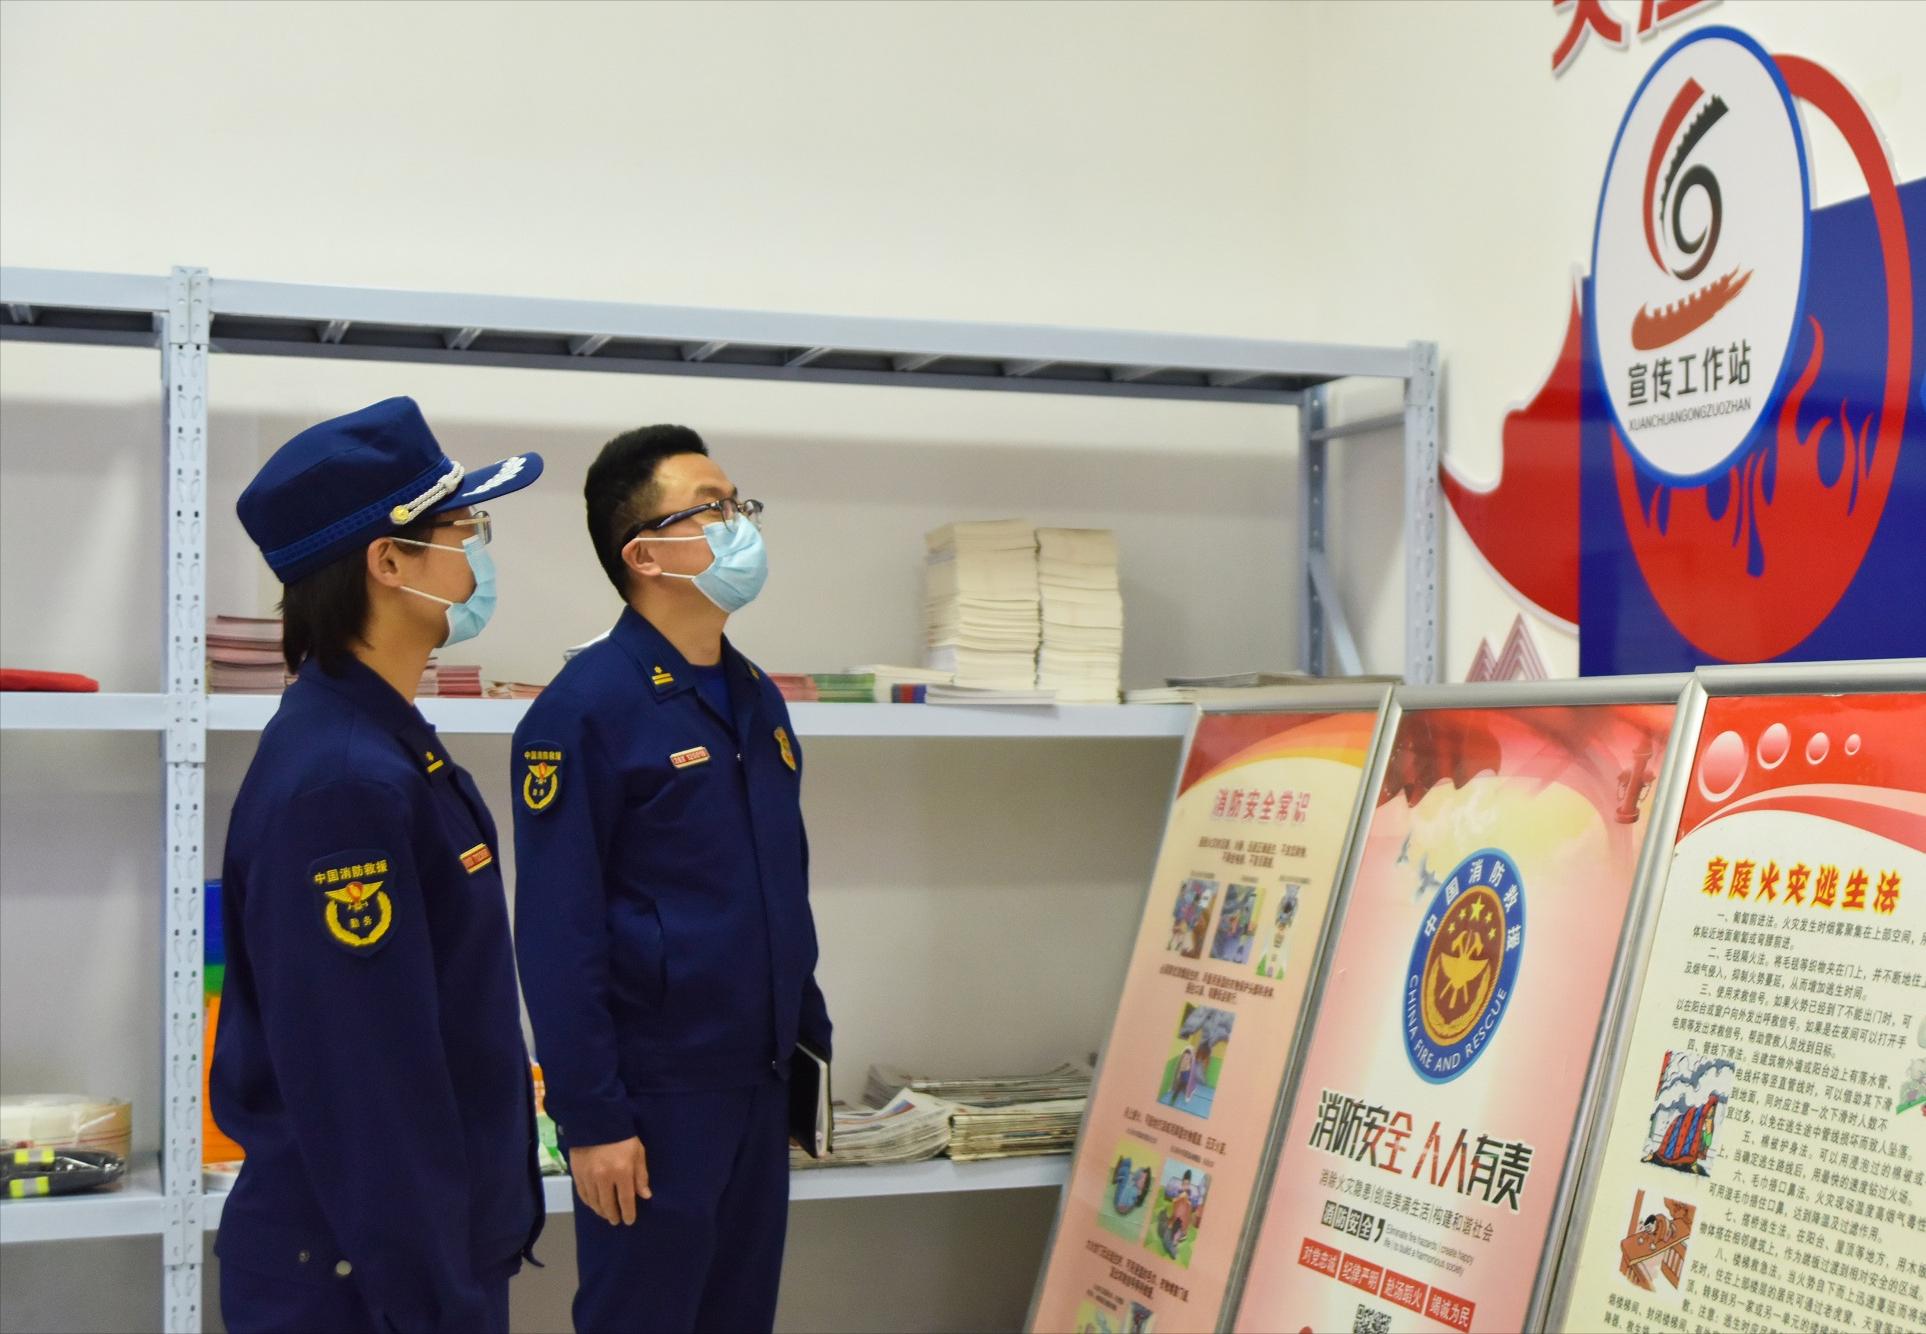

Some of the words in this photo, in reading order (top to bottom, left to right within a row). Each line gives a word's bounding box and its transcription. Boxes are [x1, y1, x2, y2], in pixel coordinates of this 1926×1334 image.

[1628, 339, 1751, 406] 宣传工作站
[1628, 398, 1751, 432] XUANCHUANGONGZUOZHAN
[314, 859, 389, 884] 中国消防救援
[1701, 856, 1902, 914] 家庭火灾逃生法
[1423, 859, 1522, 952] 中国消防救援
[1406, 974, 1418, 1041] CHINA
[1414, 1038, 1433, 1069] FIRE
[1434, 1053, 1461, 1073] AND
[1465, 987, 1507, 1058] RESCUE
[1308, 1089, 1414, 1177] 消防安全
[1411, 1121, 1534, 1212] 人人有责
[1385, 1275, 1423, 1309] 赴汤蹈火
[1431, 1294, 1472, 1327] 竭诚为民
